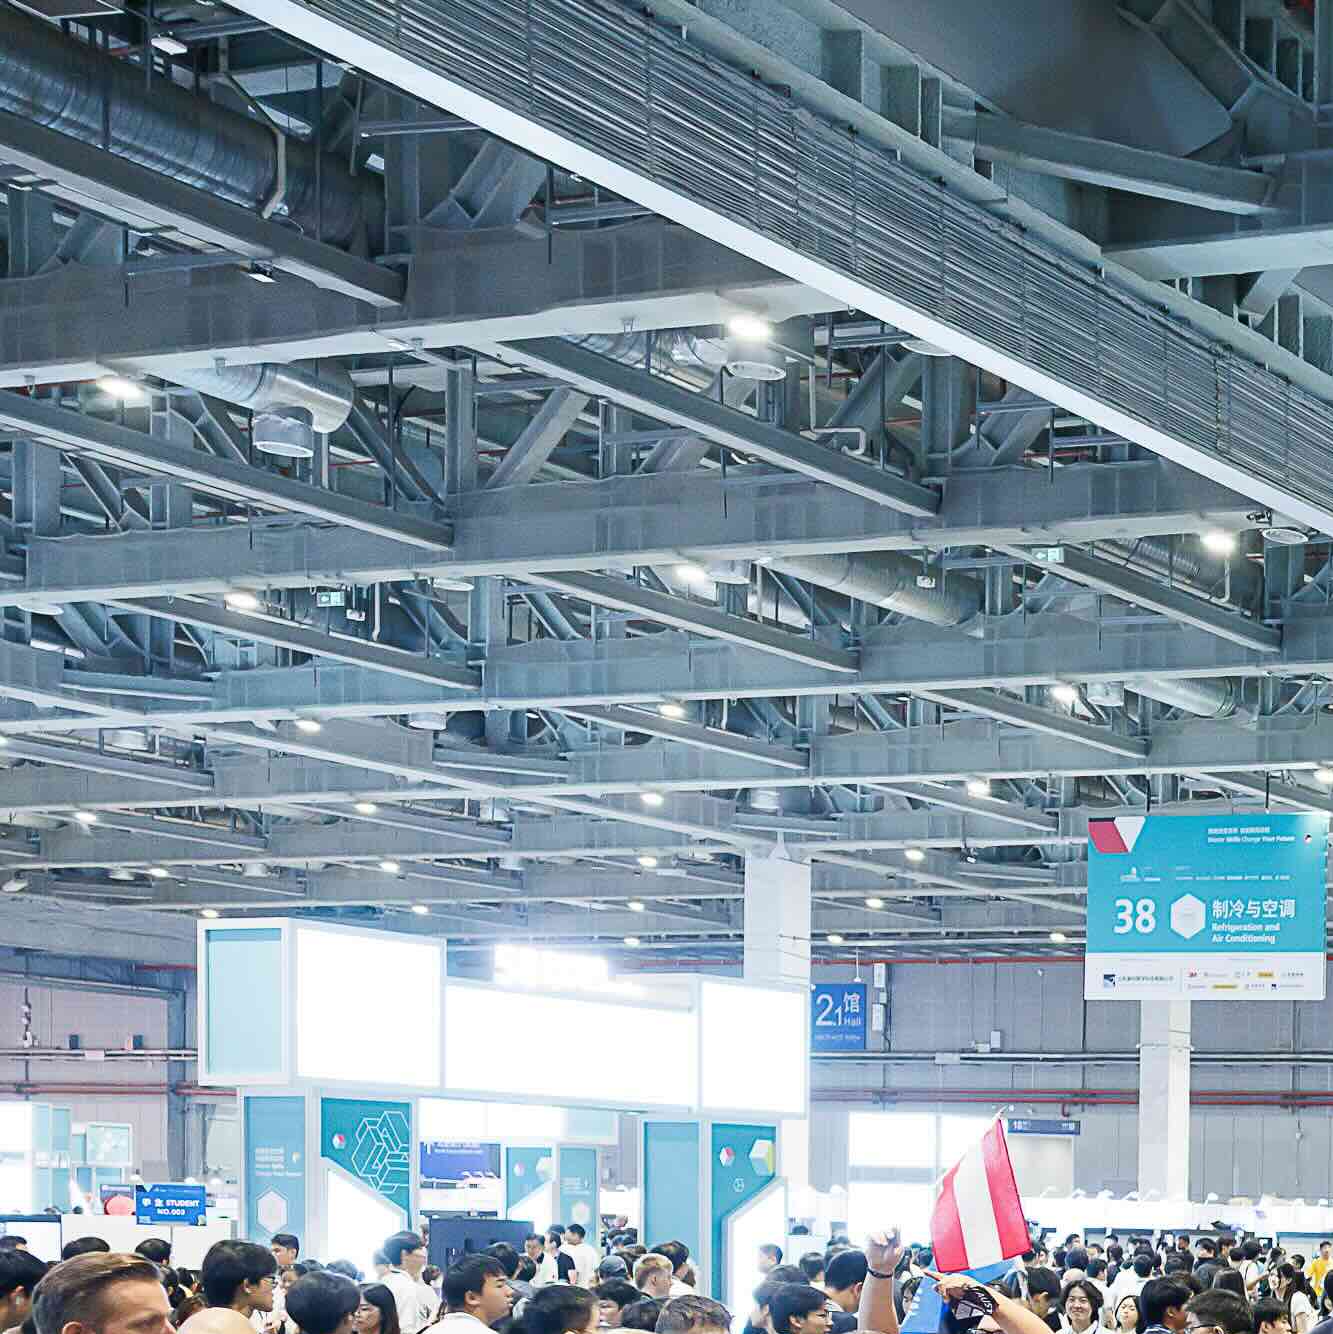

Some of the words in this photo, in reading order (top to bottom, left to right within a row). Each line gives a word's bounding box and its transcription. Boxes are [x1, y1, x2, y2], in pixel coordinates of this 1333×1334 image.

[1114, 898, 1156, 935] 38
[1212, 899, 1297, 919] 制冷与空调
[1264, 923, 1281, 932] and
[1212, 934, 1225, 943] Air
[815, 993, 843, 1026] 2.1
